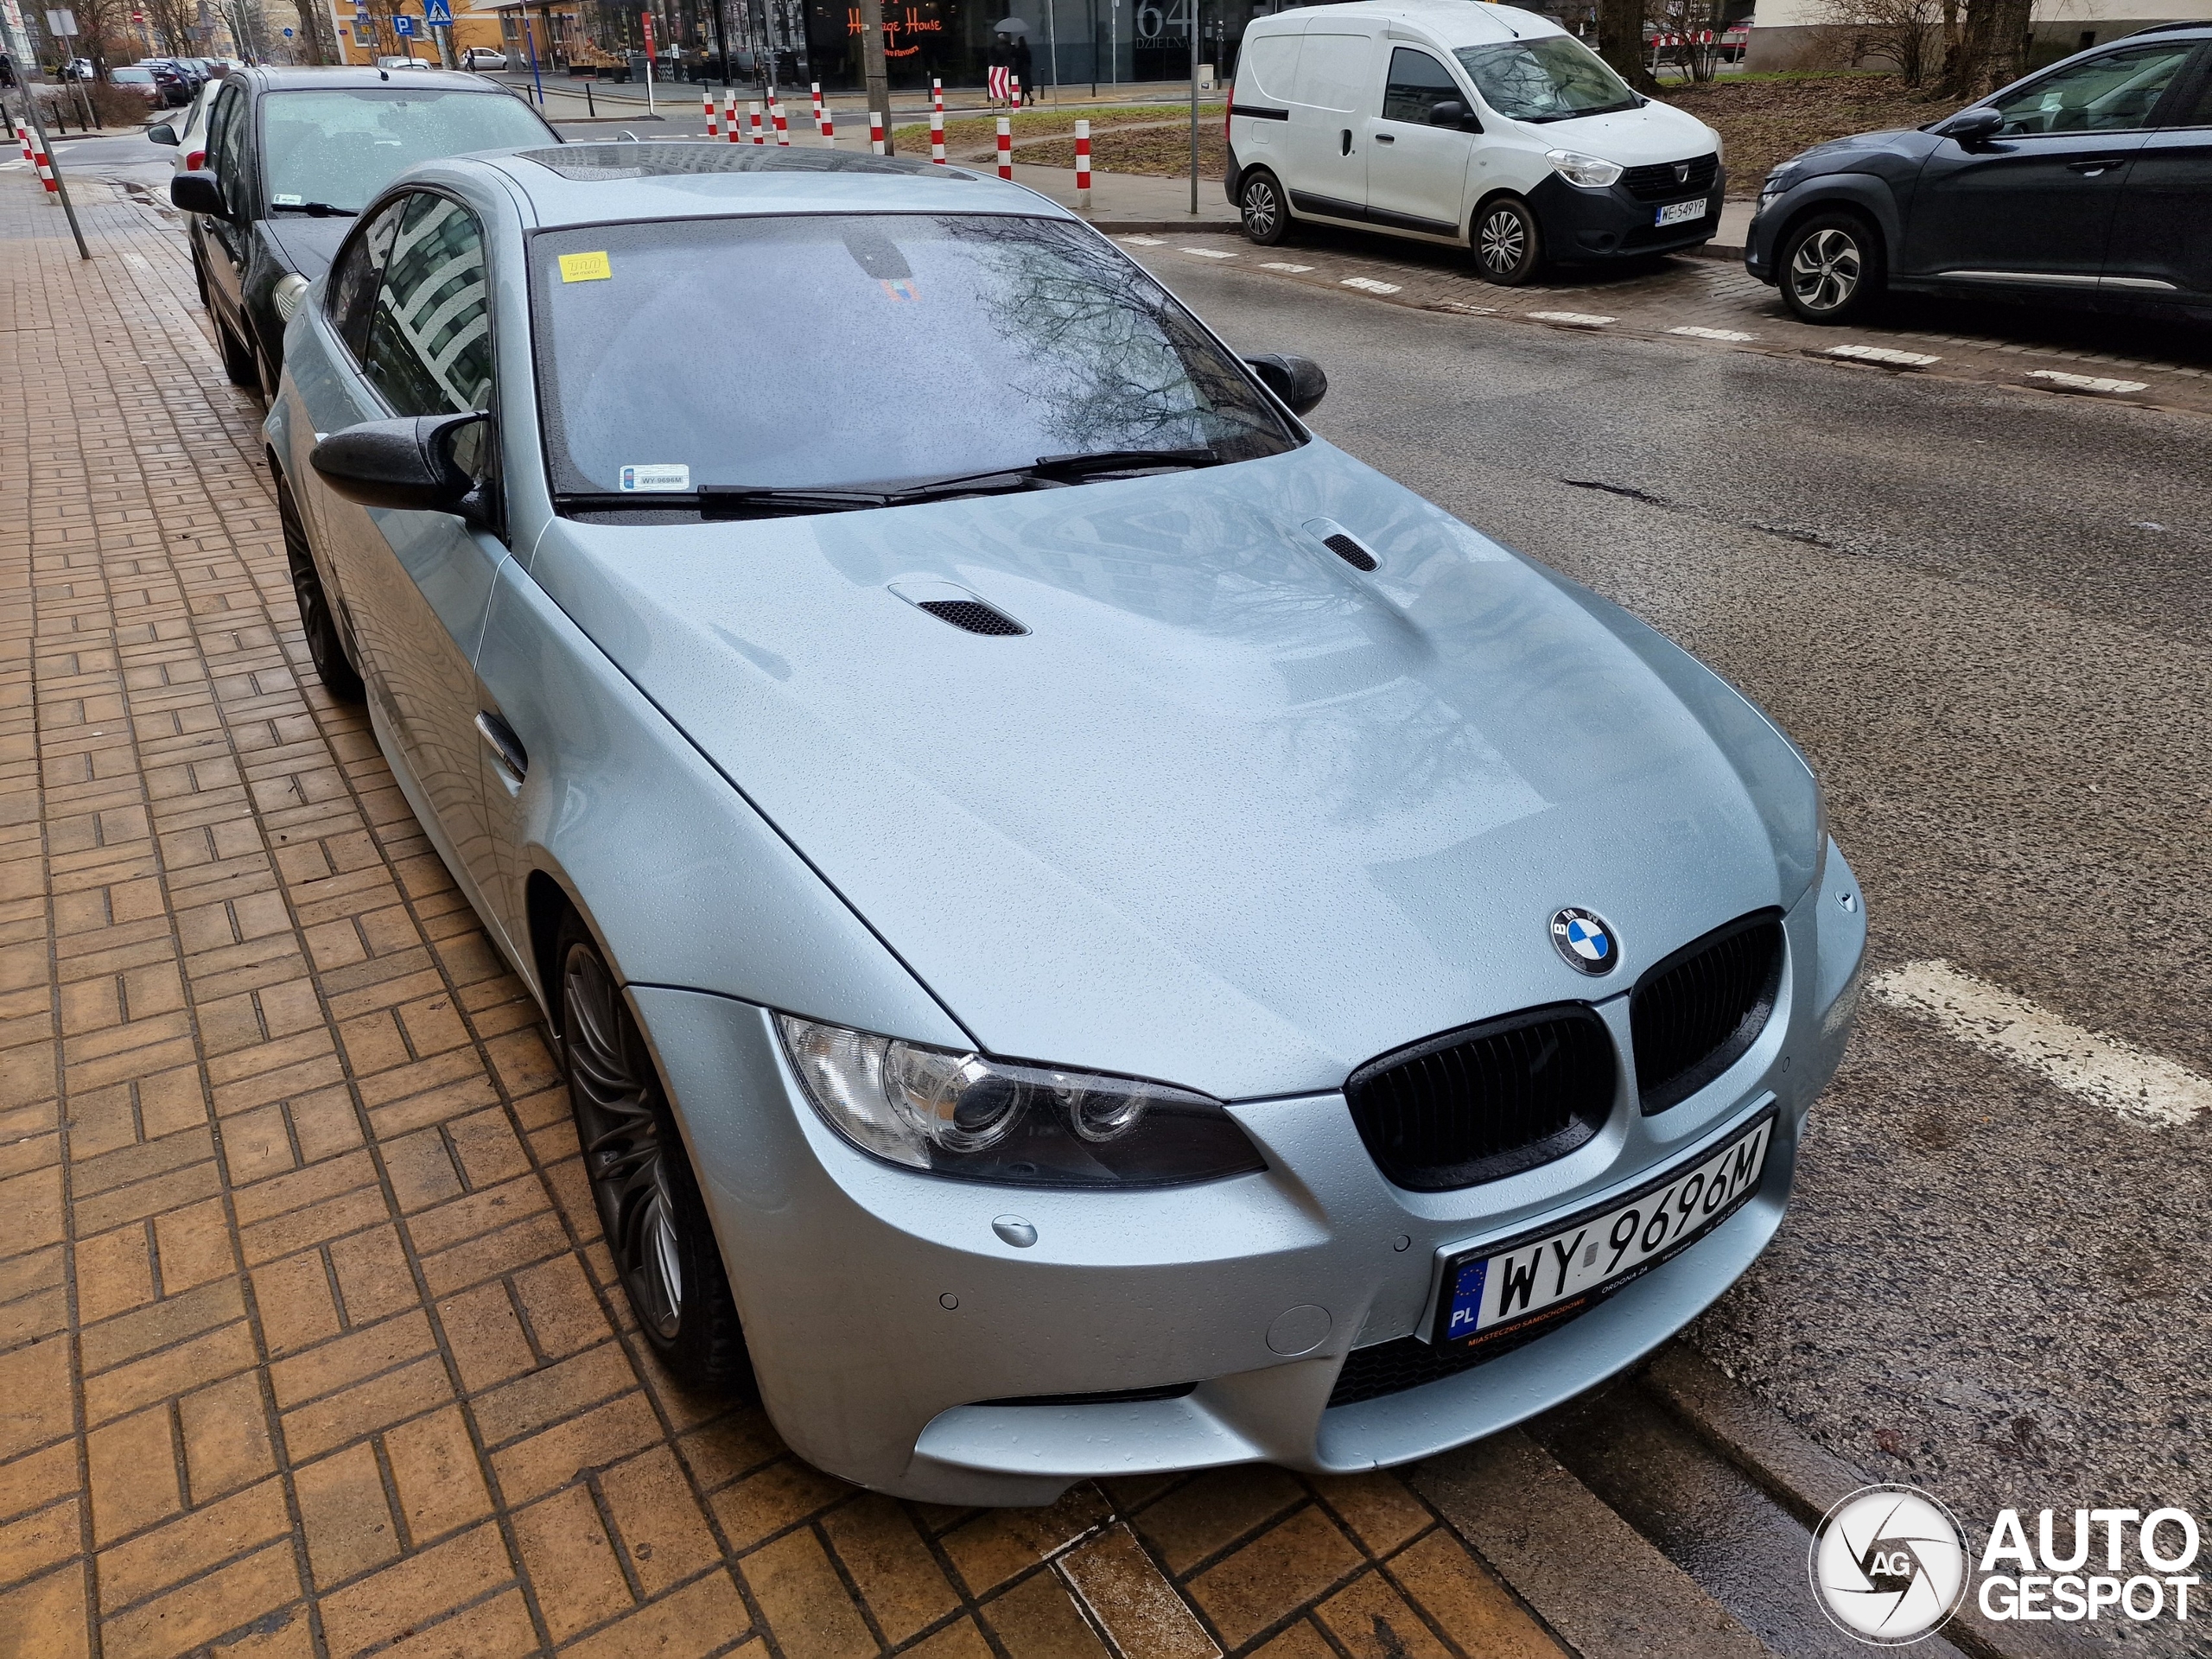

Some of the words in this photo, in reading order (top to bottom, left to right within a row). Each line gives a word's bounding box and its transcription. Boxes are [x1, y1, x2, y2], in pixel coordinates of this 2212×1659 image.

[397, 17, 410, 34] P
[906, 7, 943, 35] House
[1137, 0, 1192, 38] 64
[1135, 36, 1191, 50] DZIELNA
[1662, 206, 1675, 221] WE
[1677, 200, 1705, 218] 549YP
[1554, 909, 1600, 936] BMW
[1497, 1229, 1587, 1318] WY
[1602, 1128, 1763, 1276] 9696M
[1601, 1271, 1637, 1294] ORDONA
[1451, 1306, 1474, 1328] PL
[1467, 1323, 1522, 1347] MIASTECZKO
[1522, 1297, 1587, 1328] SAMOCHODOWE
